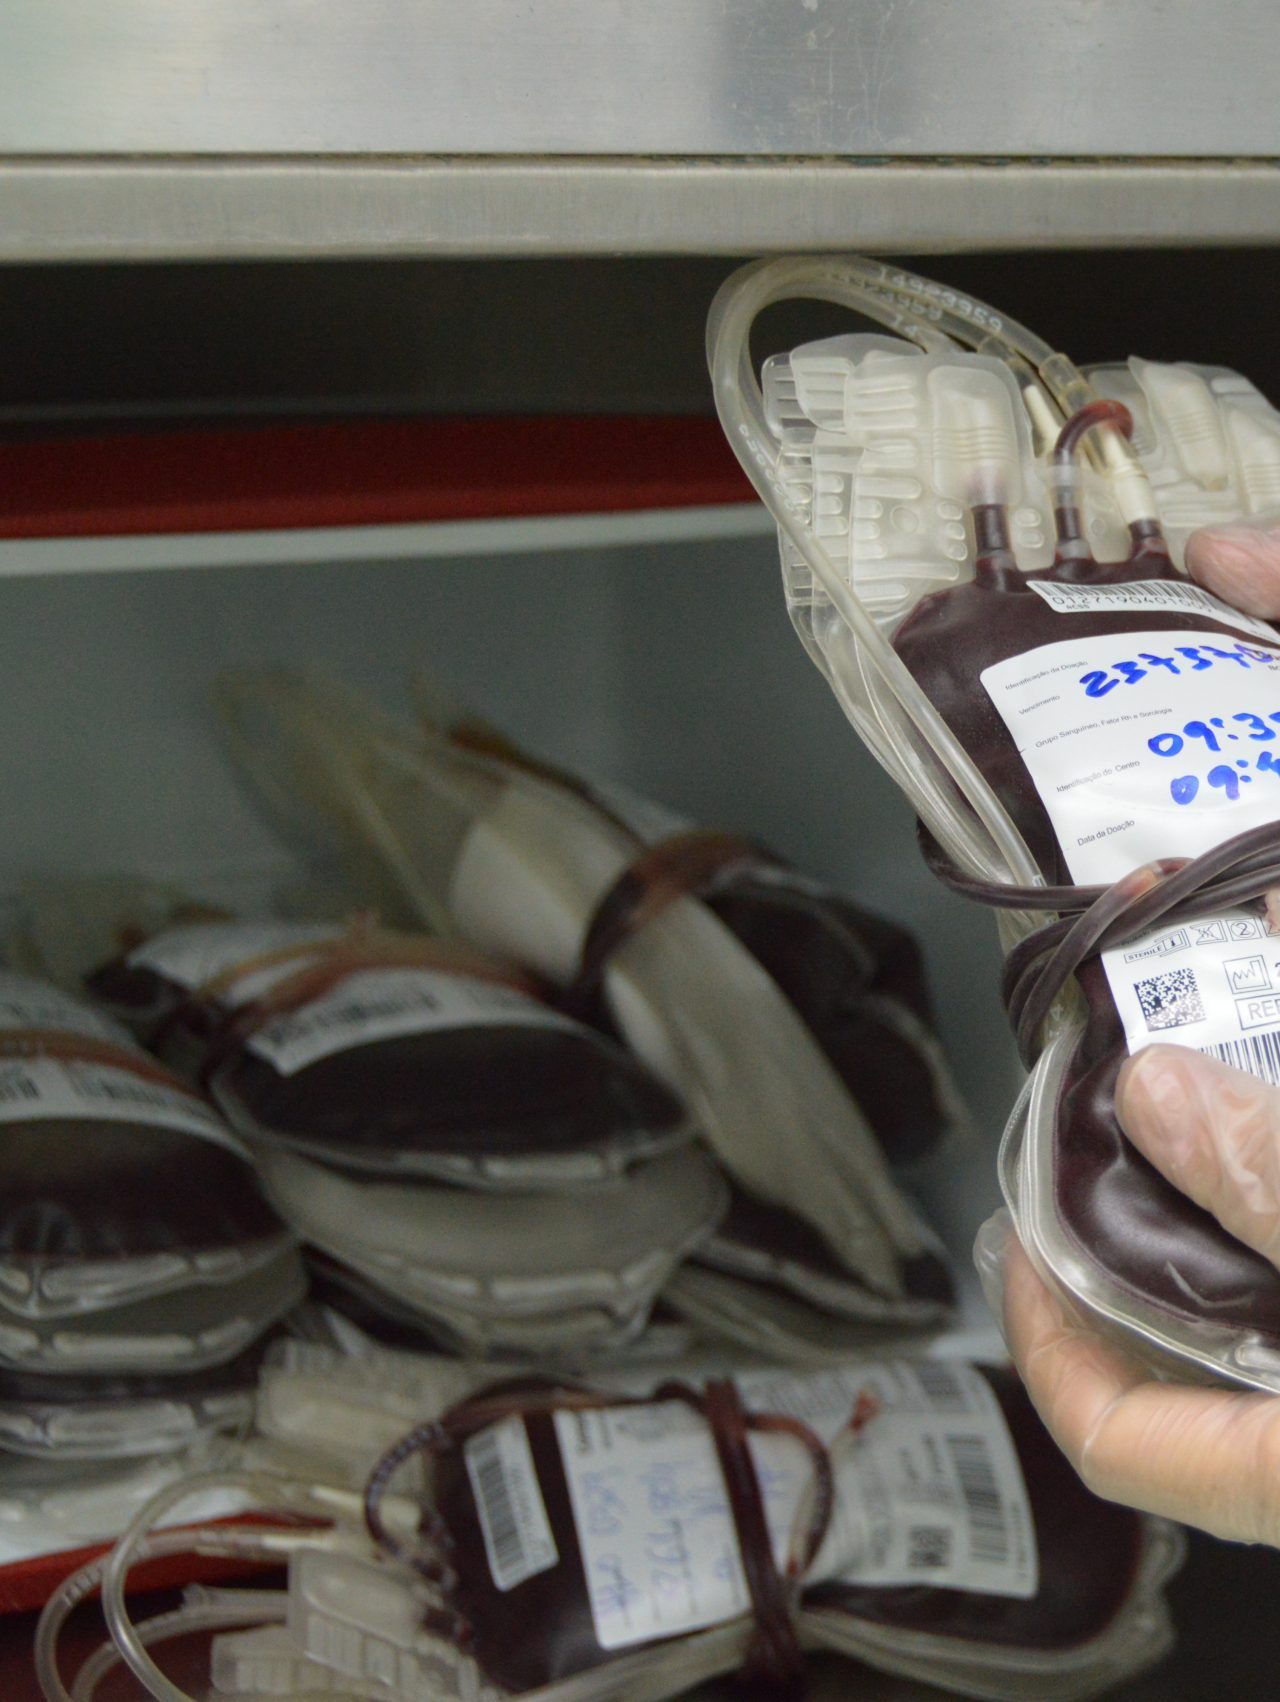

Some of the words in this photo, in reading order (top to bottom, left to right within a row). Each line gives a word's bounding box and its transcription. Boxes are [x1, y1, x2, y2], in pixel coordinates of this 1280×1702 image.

[1018, 695, 1061, 716] Vencimento
[1035, 734, 1060, 749] Grupo
[1101, 715, 1120, 727] Fator
[1056, 771, 1102, 793] Identificação
[1102, 768, 1113, 777] do
[1114, 759, 1141, 772] Centro
[1077, 833, 1096, 847] Data
[1096, 829, 1106, 839] da
[1106, 820, 1136, 835] Doação
[1127, 944, 1162, 961] STERILE
